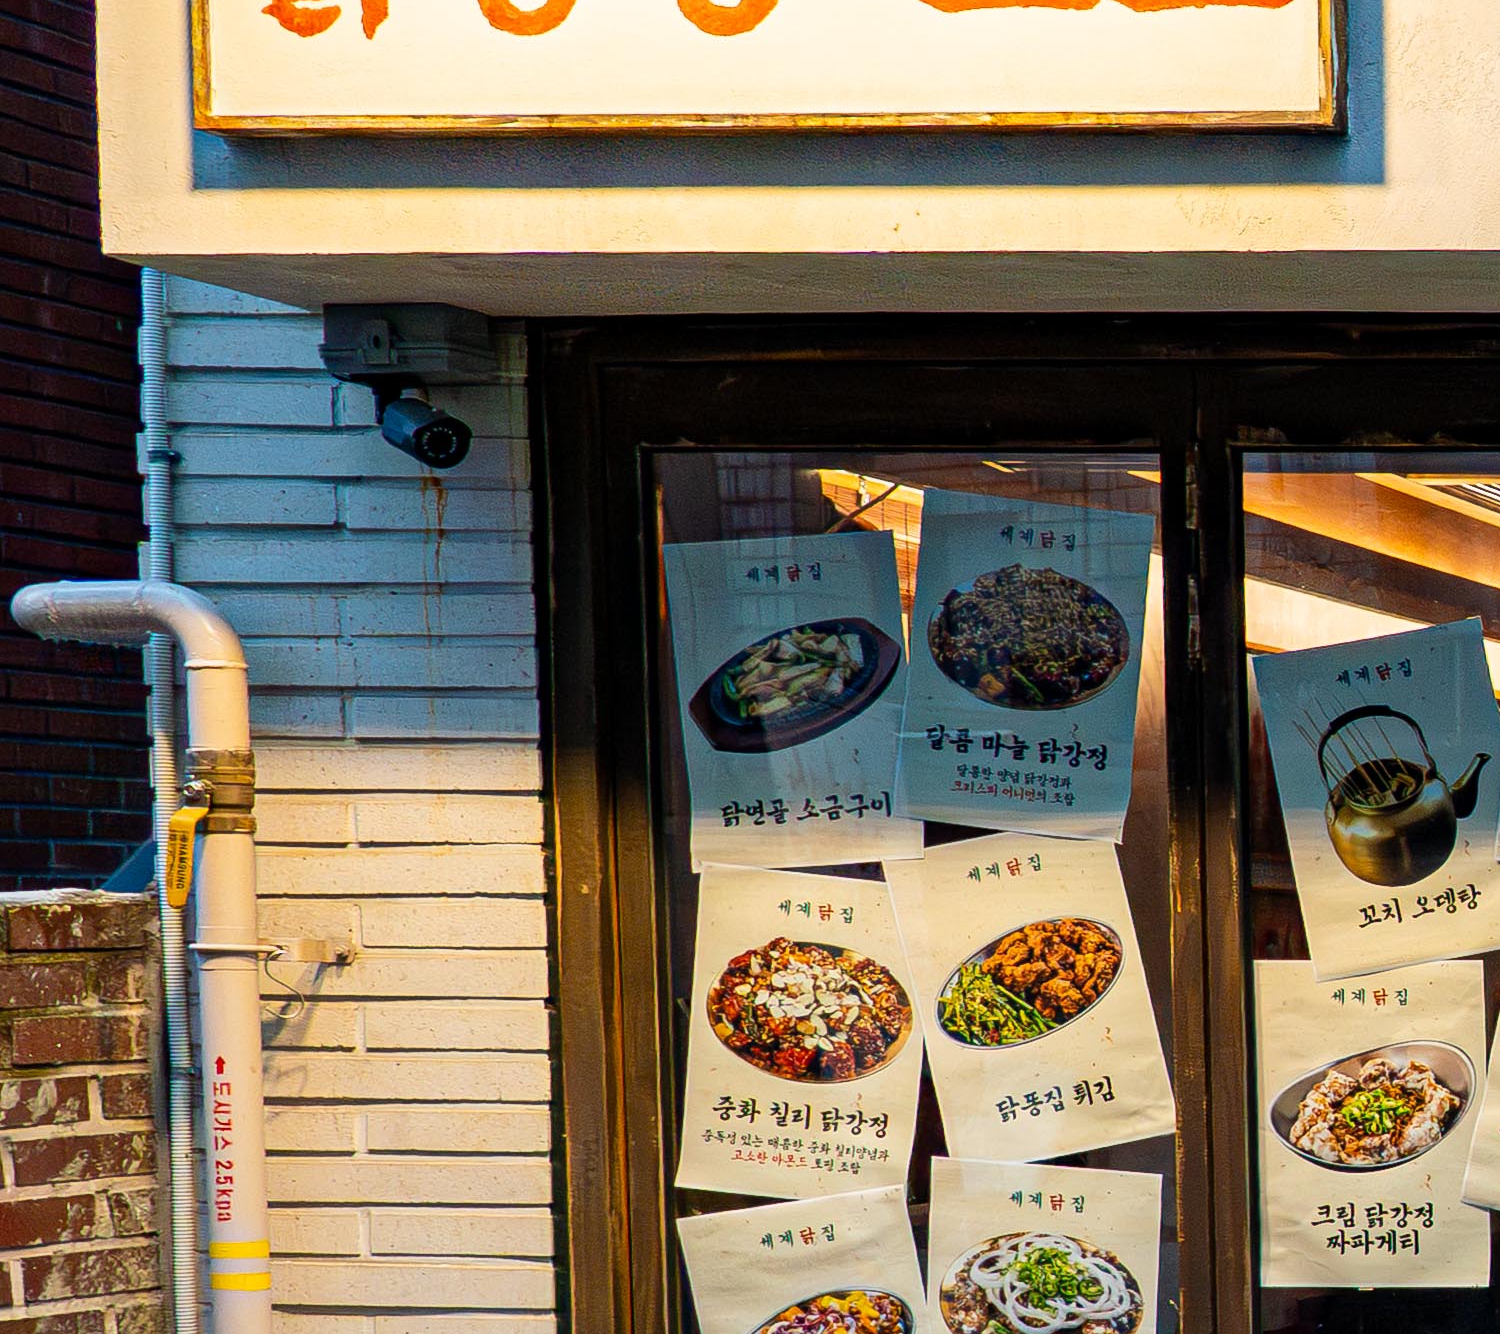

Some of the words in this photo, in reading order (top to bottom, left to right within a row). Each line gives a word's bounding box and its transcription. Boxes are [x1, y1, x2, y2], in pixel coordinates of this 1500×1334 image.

[926, 724, 973, 753] 달콤
[982, 732, 1030, 760] 마늘
[1038, 738, 1107, 771] 닭강정
[720, 800, 789, 827] 닭연골
[796, 792, 892, 823] 소금구이
[1358, 898, 1402, 929] 꼬치
[1412, 884, 1481, 919] 오뎅탕
[213, 1082, 232, 1150] 도시가스
[712, 1096, 761, 1123] 중화
[770, 1102, 812, 1129] 칠리
[820, 1107, 889, 1139] 닭강정
[995, 1089, 1064, 1124] 닭똥집
[1073, 1077, 1117, 1105] 튀김
[1311, 1205, 1355, 1227] 크림
[1364, 1202, 1434, 1229] 닭강정
[1326, 1229, 1420, 1255] 짜파게티
